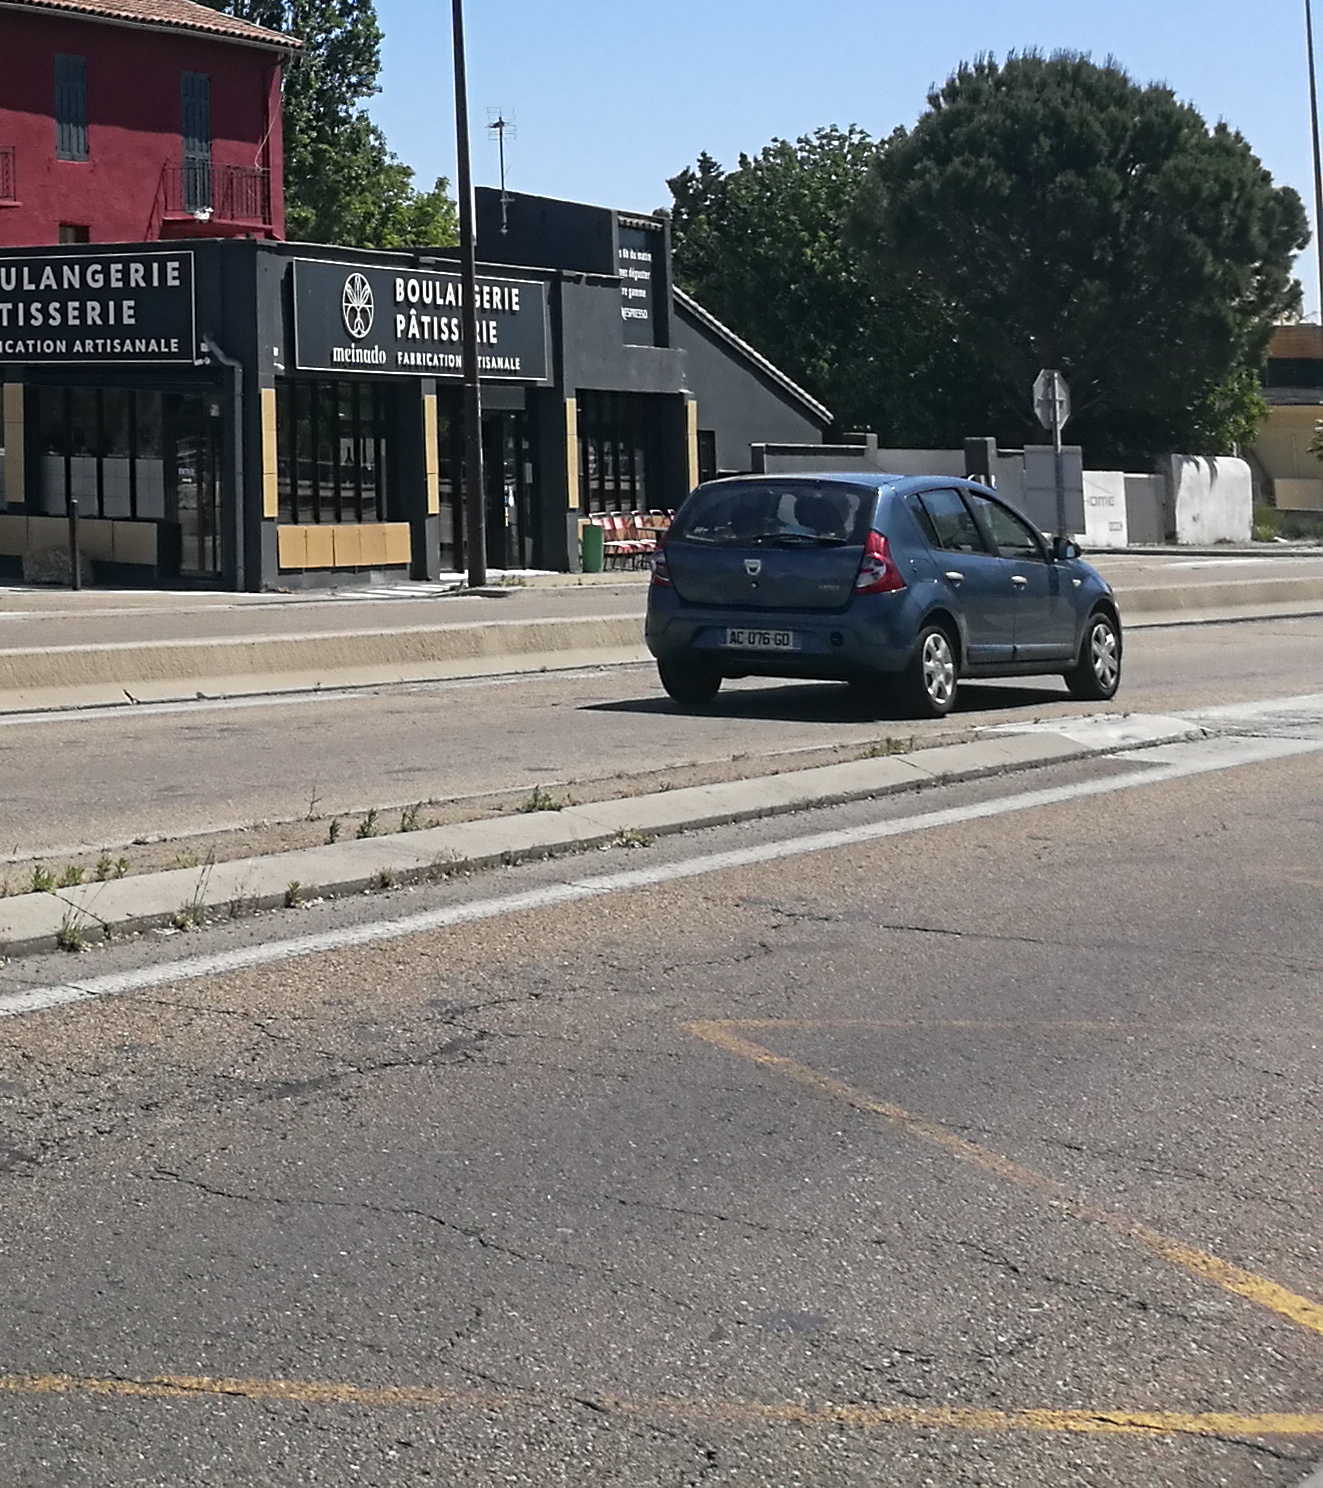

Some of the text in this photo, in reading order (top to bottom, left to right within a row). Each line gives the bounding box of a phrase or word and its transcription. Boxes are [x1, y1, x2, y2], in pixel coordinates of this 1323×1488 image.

[396, 308, 498, 344] PÂTISSRIE
[72, 338, 180, 353] ARTISANALE
[333, 343, 387, 365] meinado
[397, 351, 521, 371] FABRICATION TISANALE
